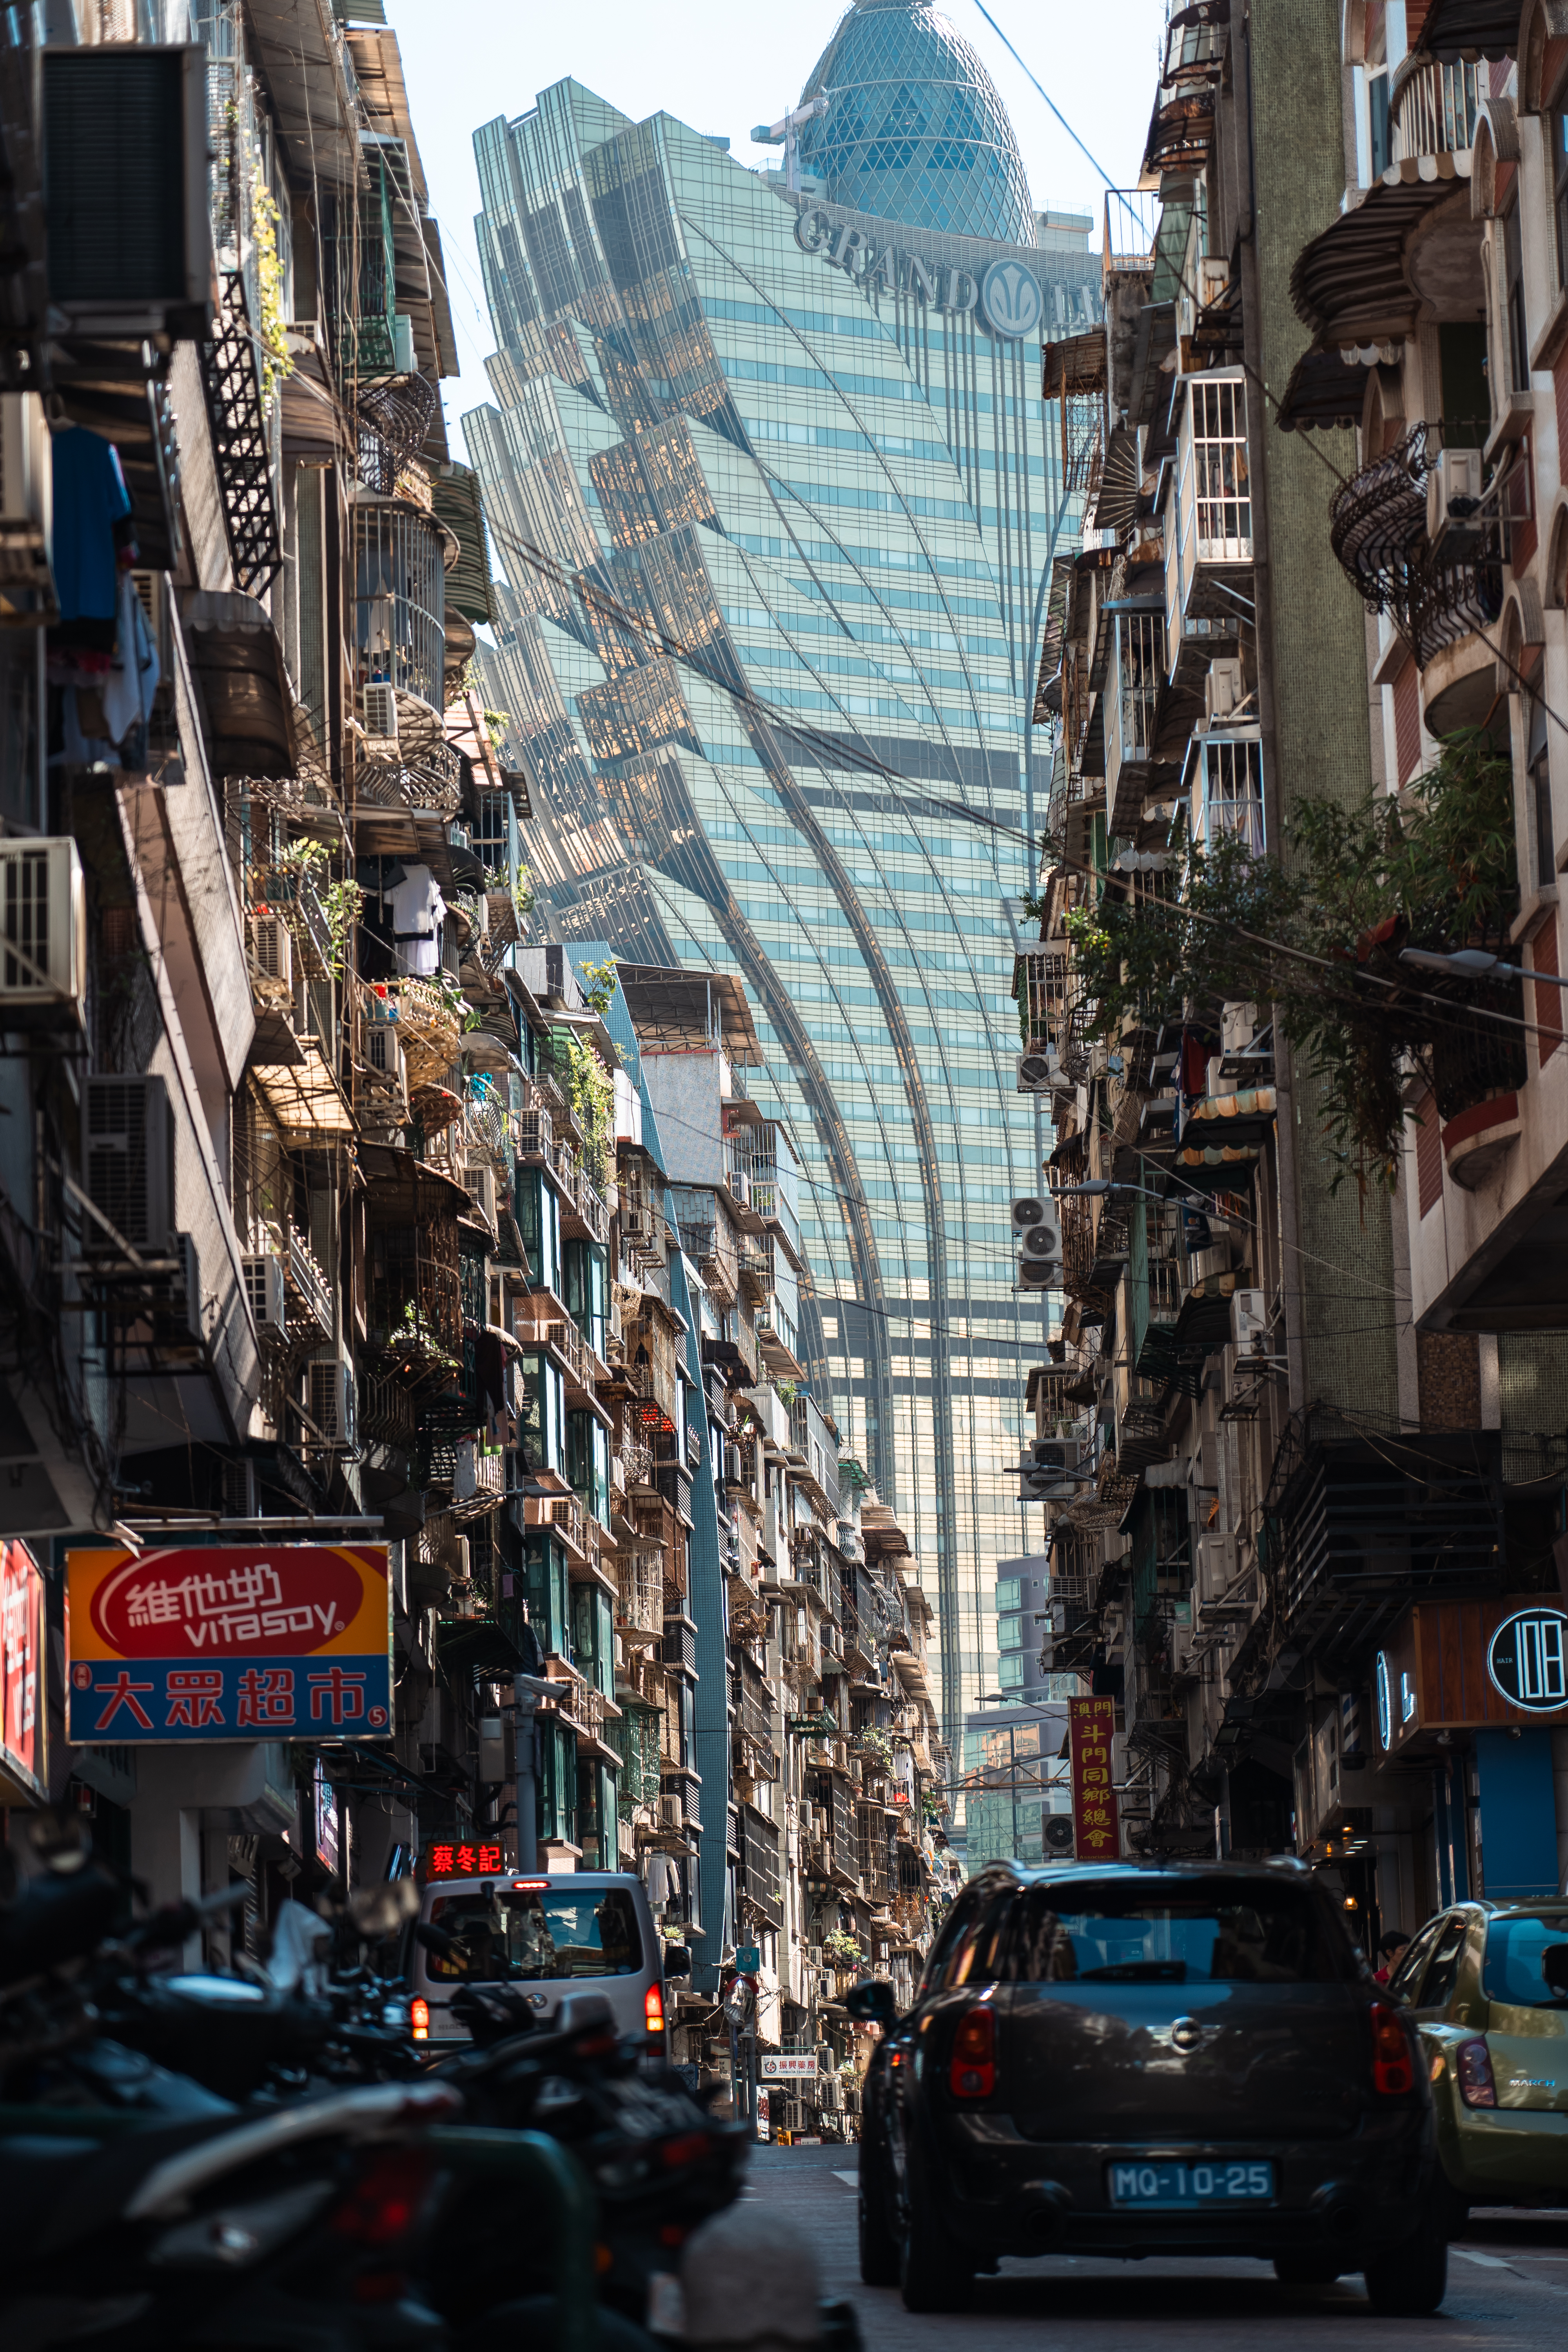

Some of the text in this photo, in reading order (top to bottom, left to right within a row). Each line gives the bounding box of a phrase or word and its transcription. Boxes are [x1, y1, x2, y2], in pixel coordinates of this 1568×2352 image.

[795, 208, 979, 311] GRAND
[125, 1563, 282, 1628] 維他奶
[94, 1667, 367, 1730] 大眾超市
[1073, 1701, 1111, 1719] 澳門
[372, 1708, 384, 1725] 5
[1081, 1724, 1113, 1847] 斗門同鄉總會
[433, 1845, 501, 1872] 蔡冬記
[779, 2060, 815, 2069] 振興藥房
[1509, 2078, 1556, 2087] MARCH
[1116, 2166, 1269, 2196] MQ-10-25
